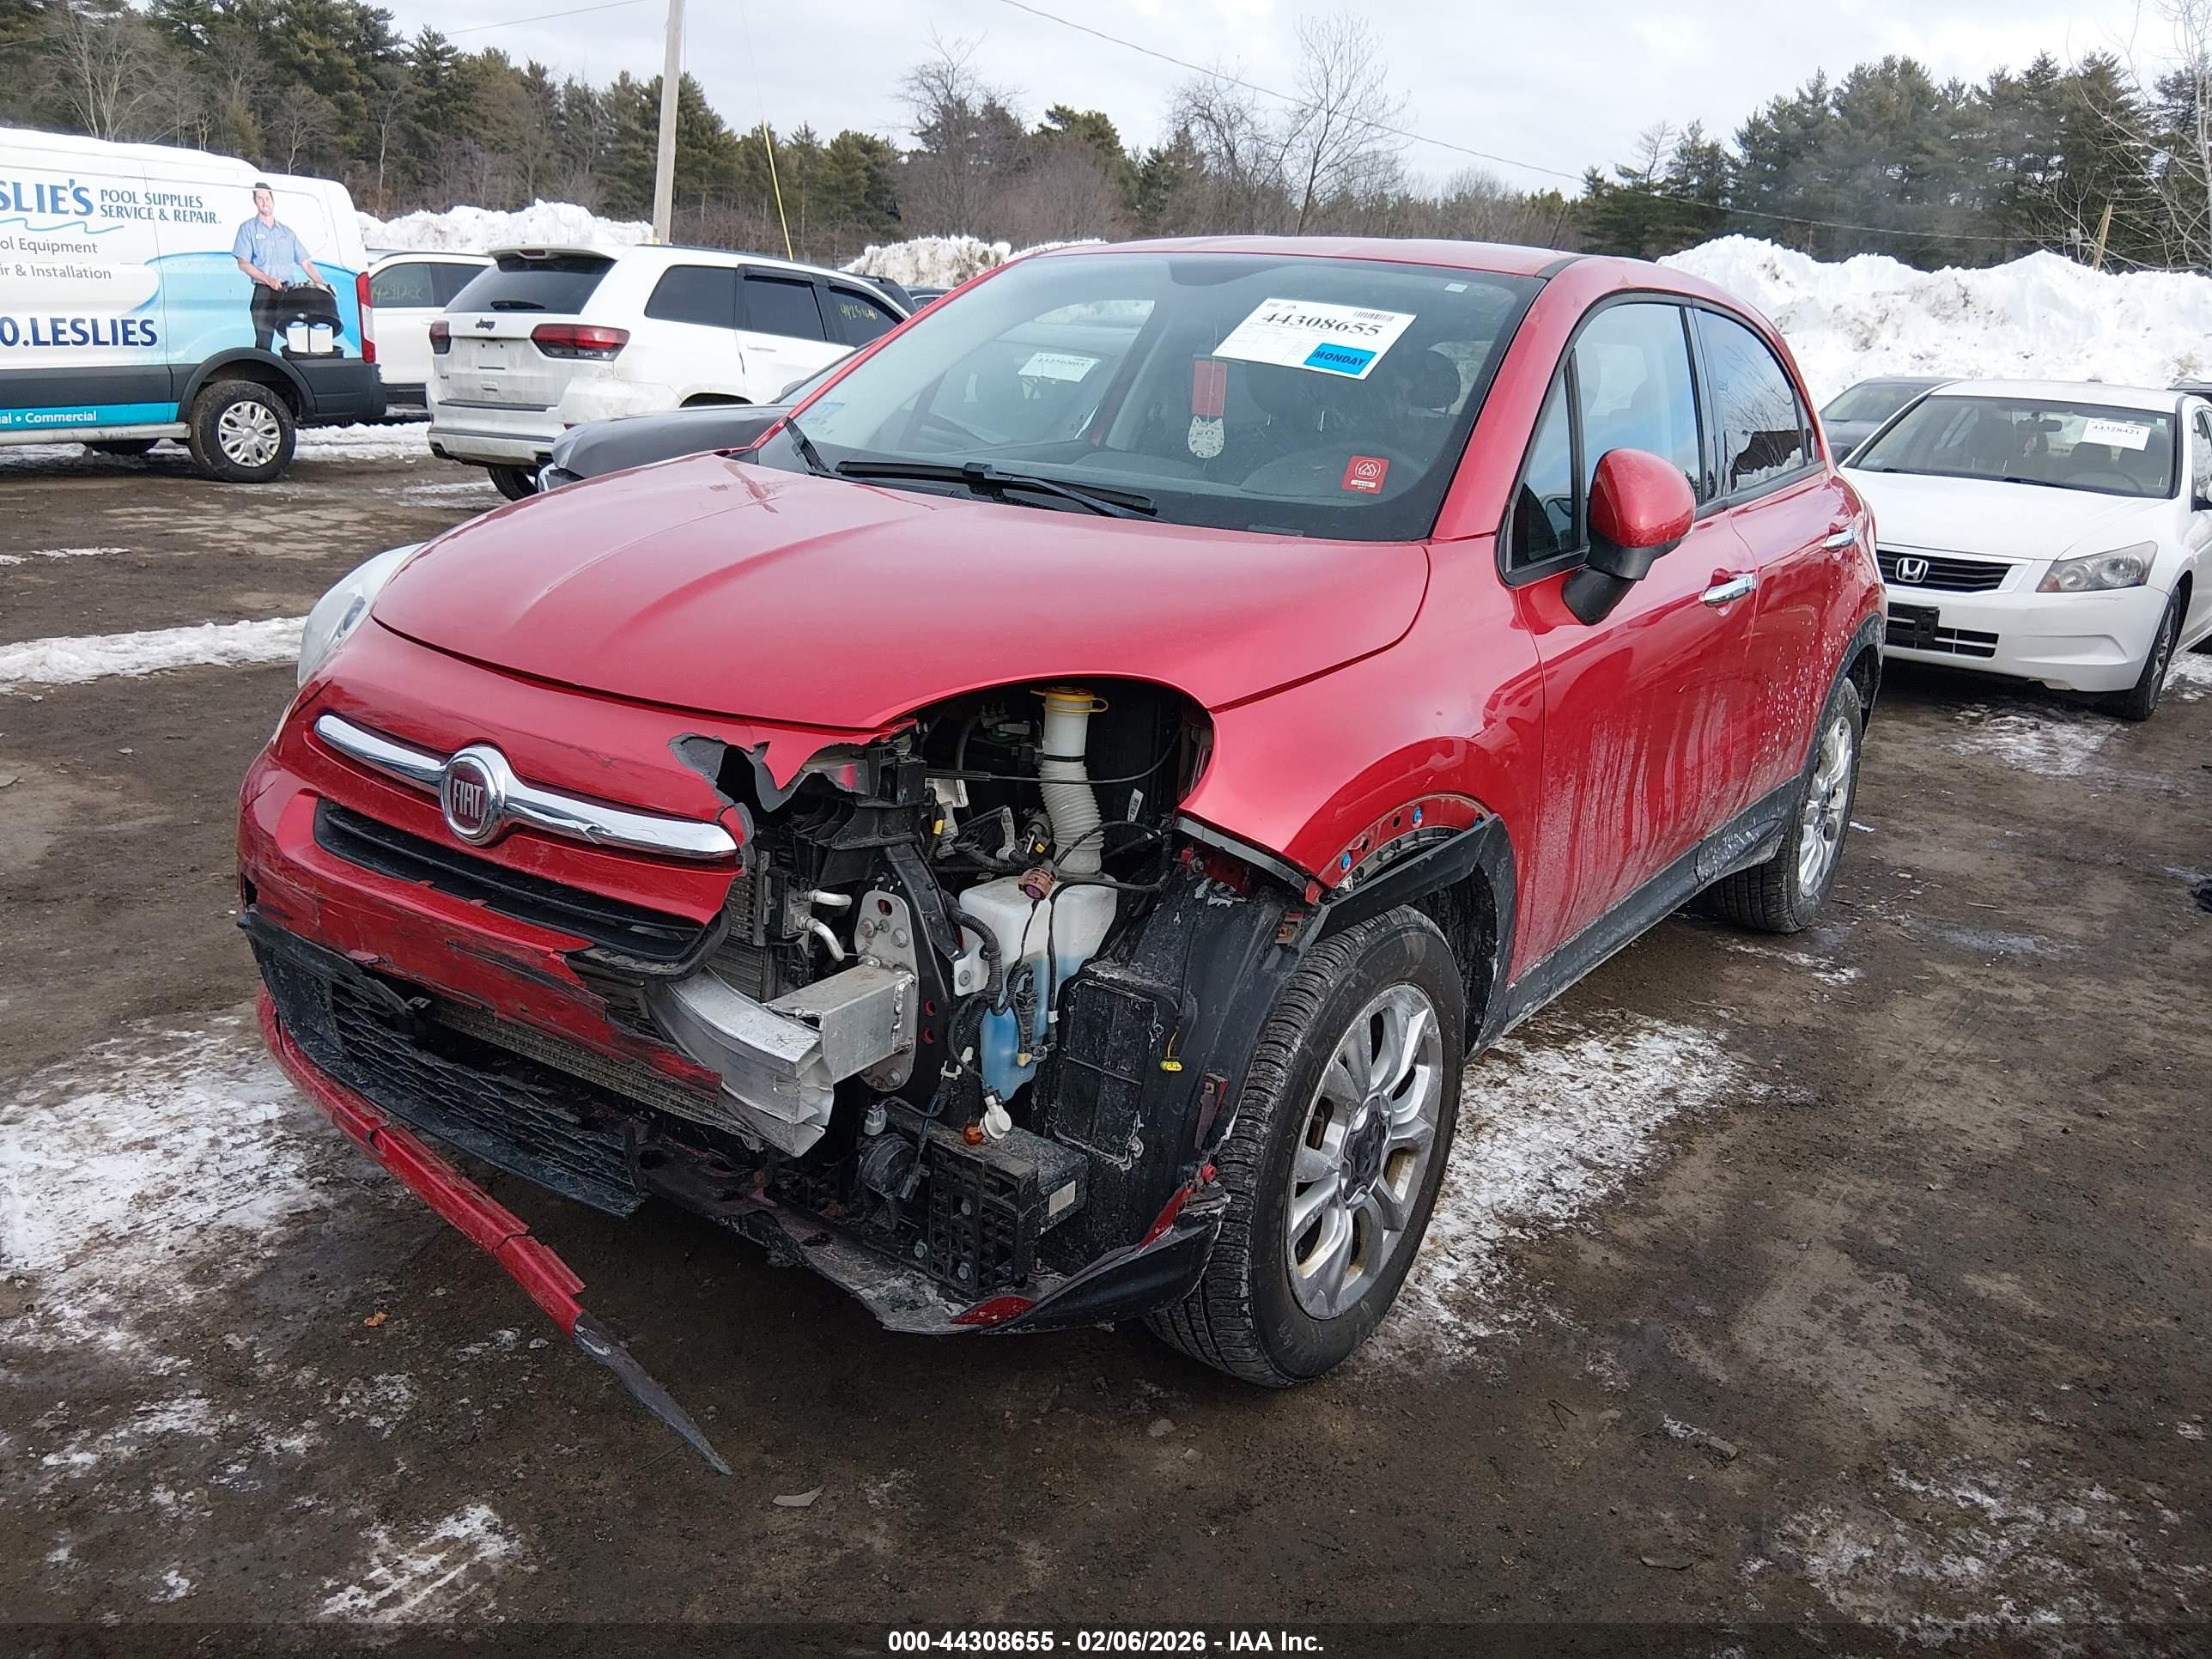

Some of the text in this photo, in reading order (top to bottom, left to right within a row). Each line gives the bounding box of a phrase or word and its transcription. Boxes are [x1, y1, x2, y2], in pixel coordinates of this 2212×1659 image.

[100, 189, 203, 209] POOL SUPPLIES
[100, 204, 154, 220] SERVICE
[158, 207, 170, 221] &
[19, 237, 98, 255] Equipment
[15, 264, 27, 277] &
[32, 264, 112, 279] Installation
[1261, 313, 1383, 337] 44308655
[1312, 350, 1366, 367] MONDAY
[25, 410, 97, 423] Commercial
[453, 778, 484, 819] FIAT
